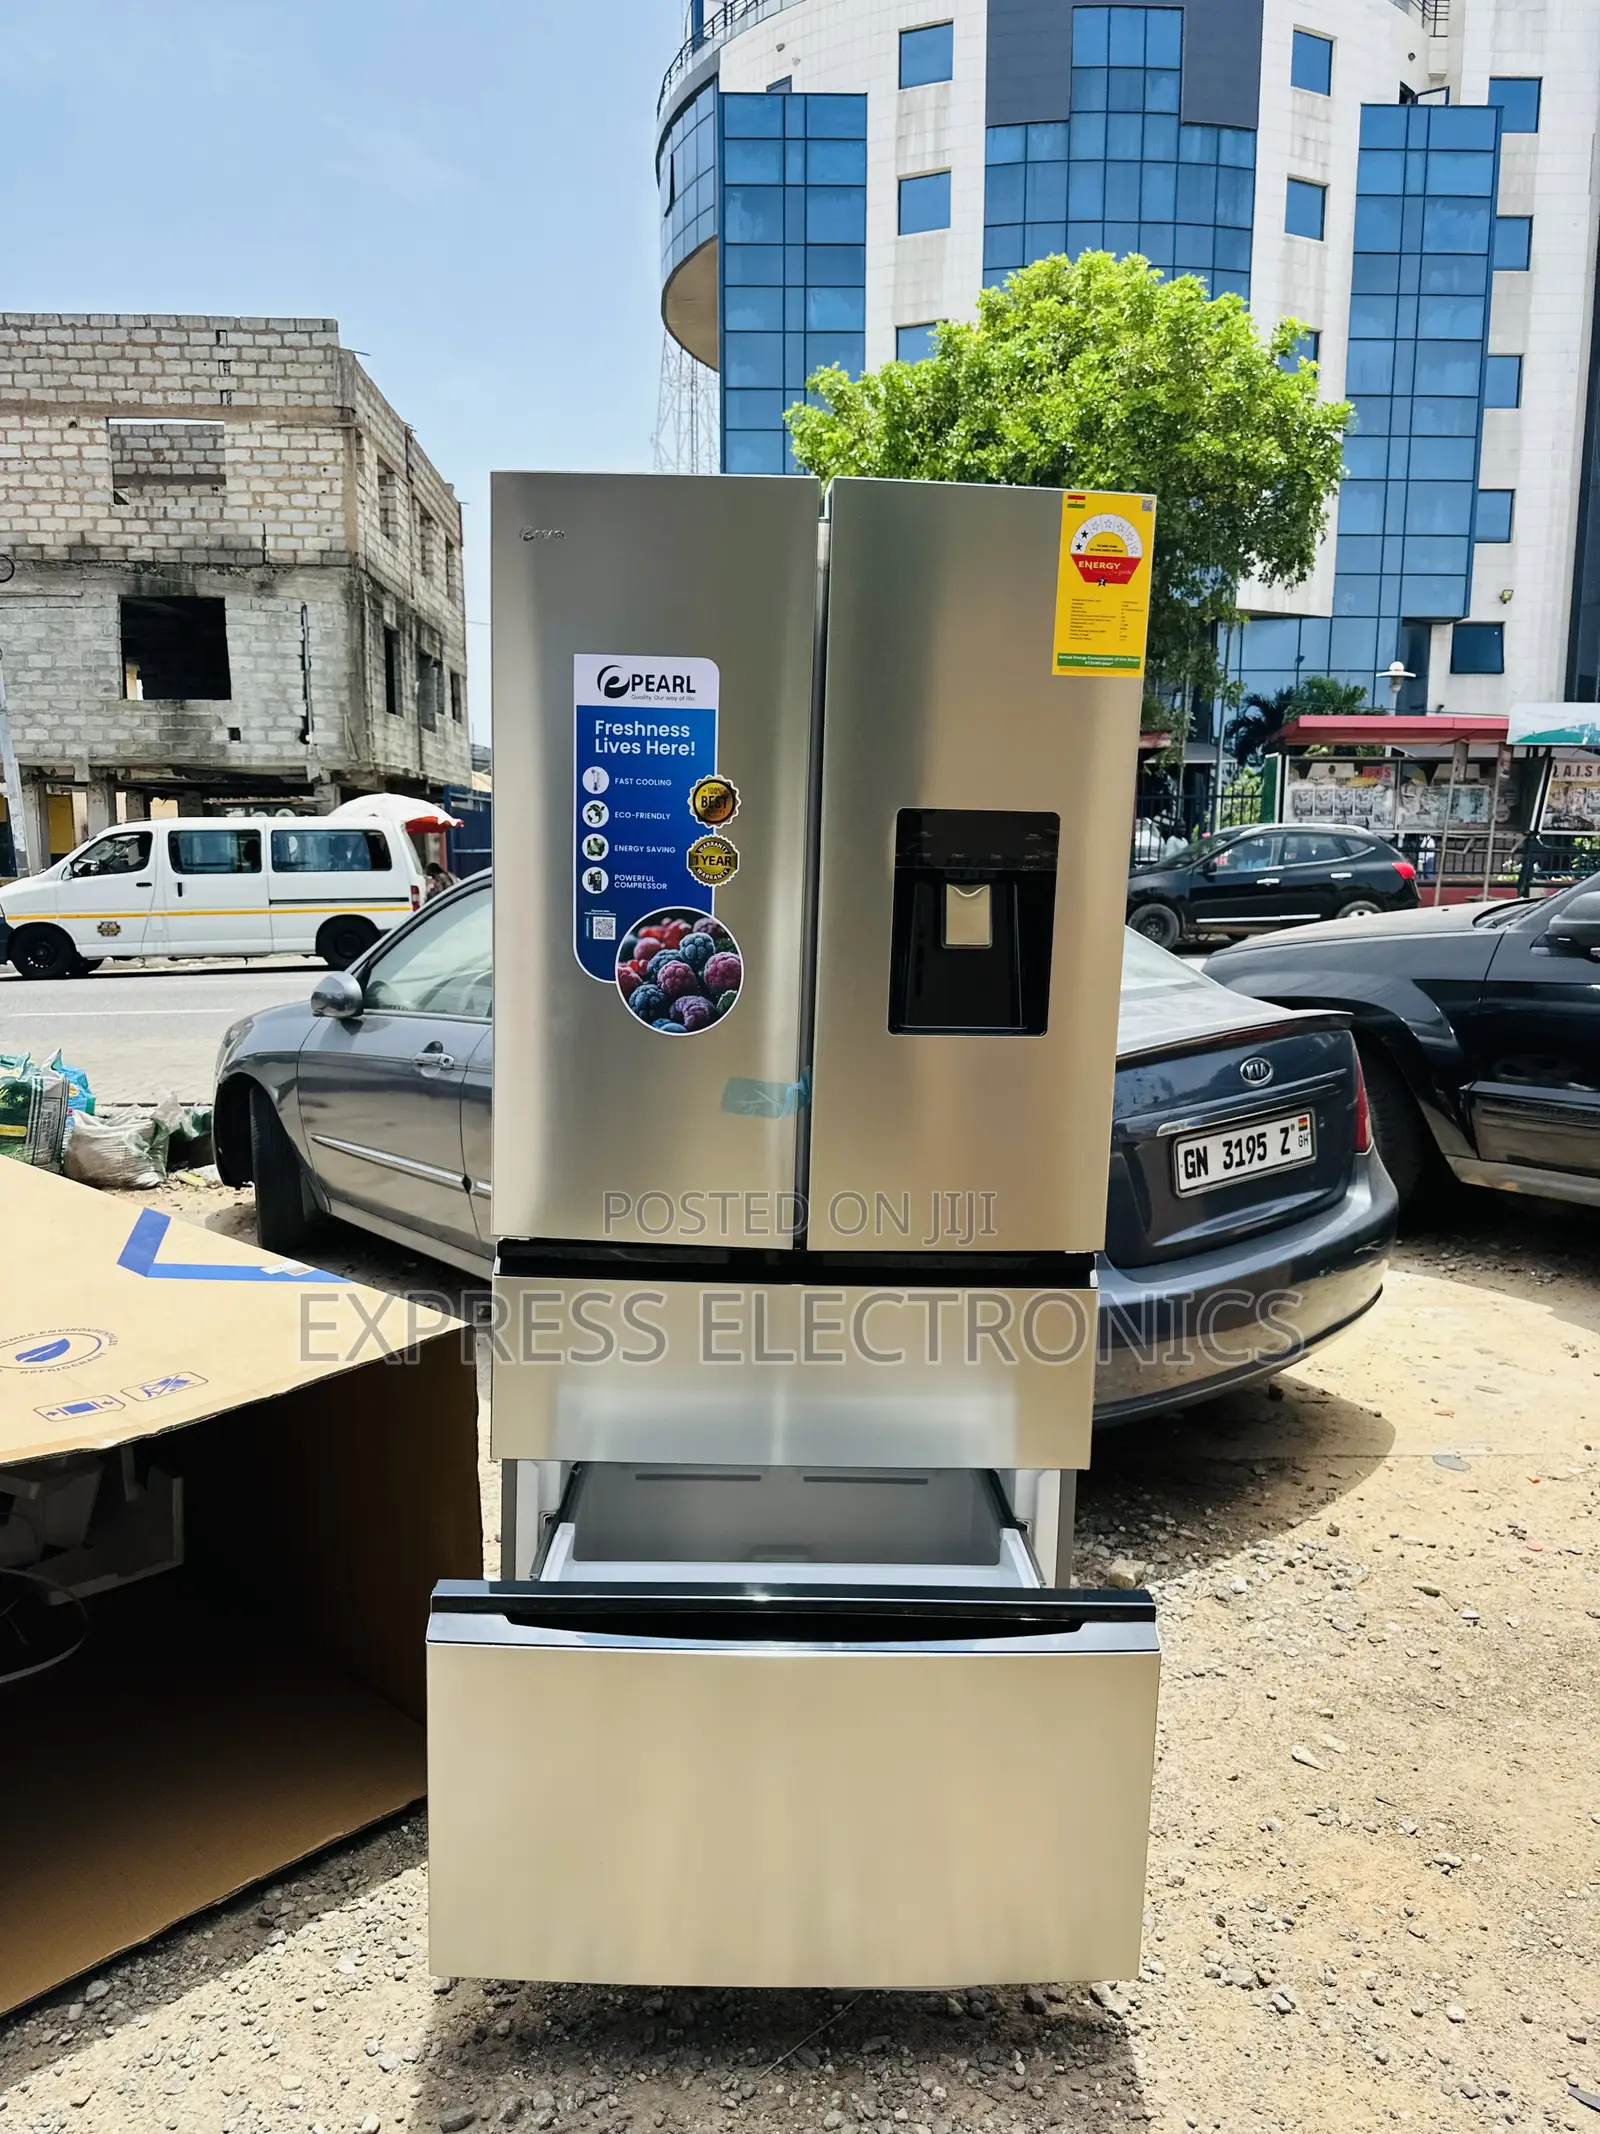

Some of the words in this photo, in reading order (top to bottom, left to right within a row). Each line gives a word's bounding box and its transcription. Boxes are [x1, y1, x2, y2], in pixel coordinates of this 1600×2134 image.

[1078, 560, 1121, 570] ENERGY
[631, 673, 696, 694] PEARL
[595, 720, 690, 738] Freshness
[595, 738, 641, 754] Lives
[646, 740, 695, 756] Here!
[614, 777, 633, 785] FAST
[635, 778, 672, 787] COOLING
[701, 795, 727, 809] BEST
[614, 811, 671, 820] ECO-FRIENDLY
[614, 844, 644, 853] ENERGY
[646, 845, 676, 854] SAVING
[698, 841, 729, 853] WARRANTY
[694, 855, 699, 866] 1
[701, 855, 732, 866] YEAR
[614, 874, 655, 882] POWERFUL
[697, 867, 728, 880] WARRANTY
[614, 881, 668, 890] COMPRESSOR
[1246, 1062, 1267, 1079] KIA
[1298, 1133, 1309, 1148] GH
[1184, 1146, 1209, 1180] GN
[1222, 1132, 1267, 1170] 3195
[1280, 1126, 1291, 1156] Z
